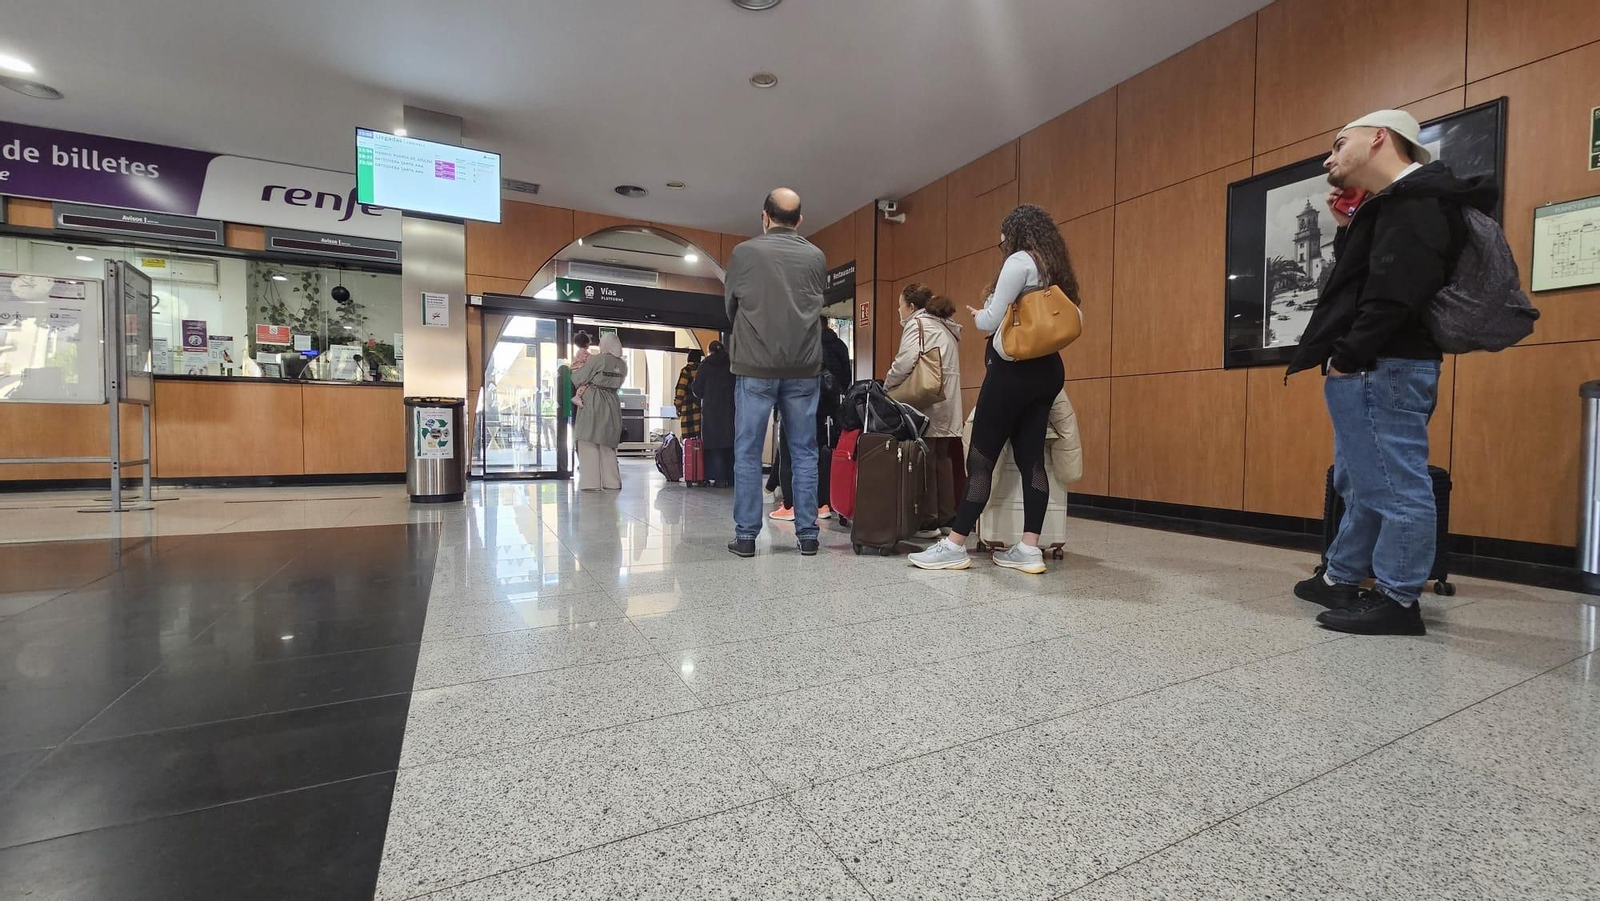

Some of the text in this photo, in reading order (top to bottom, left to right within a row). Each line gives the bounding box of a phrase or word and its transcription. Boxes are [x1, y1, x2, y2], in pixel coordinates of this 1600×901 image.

[3, 139, 160, 179] de billetes
[122, 214, 144, 223] Avisos
[320, 237, 338, 245] Avisos
[833, 266, 855, 280] Restaurante
[600, 286, 617, 297] Vías
